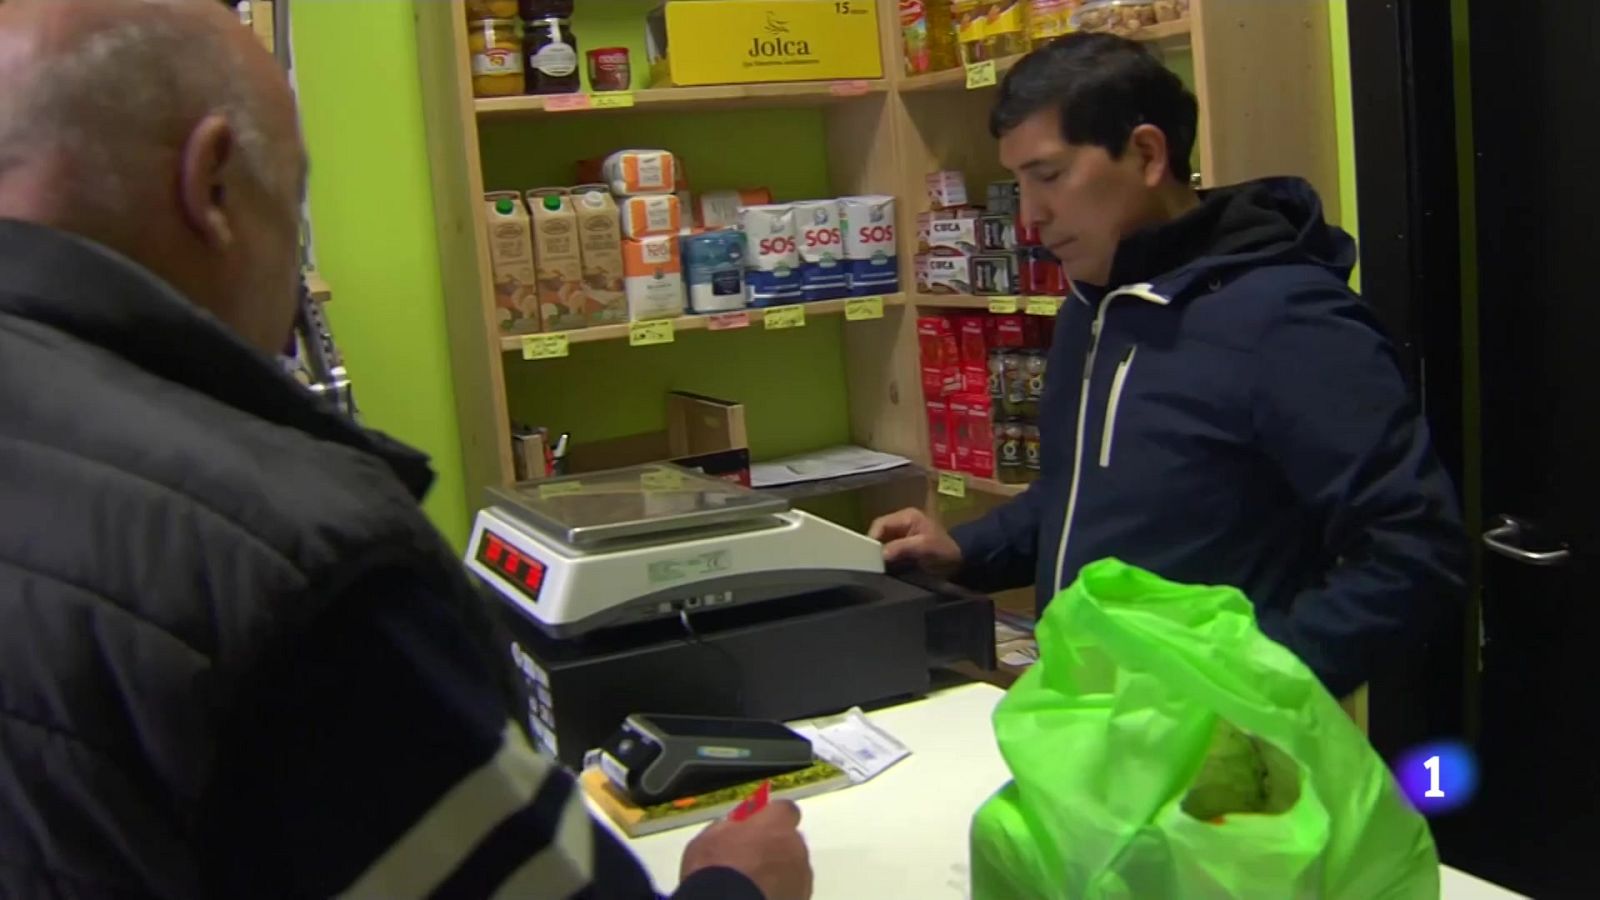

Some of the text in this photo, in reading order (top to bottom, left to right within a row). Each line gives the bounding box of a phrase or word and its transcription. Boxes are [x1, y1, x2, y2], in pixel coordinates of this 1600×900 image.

[834, 1, 850, 15] 15
[748, 37, 810, 57] Jolca
[860, 225, 893, 243] SOS
[934, 223, 960, 232] CUCA
[760, 235, 796, 255] SOS
[805, 228, 841, 246] SOS
